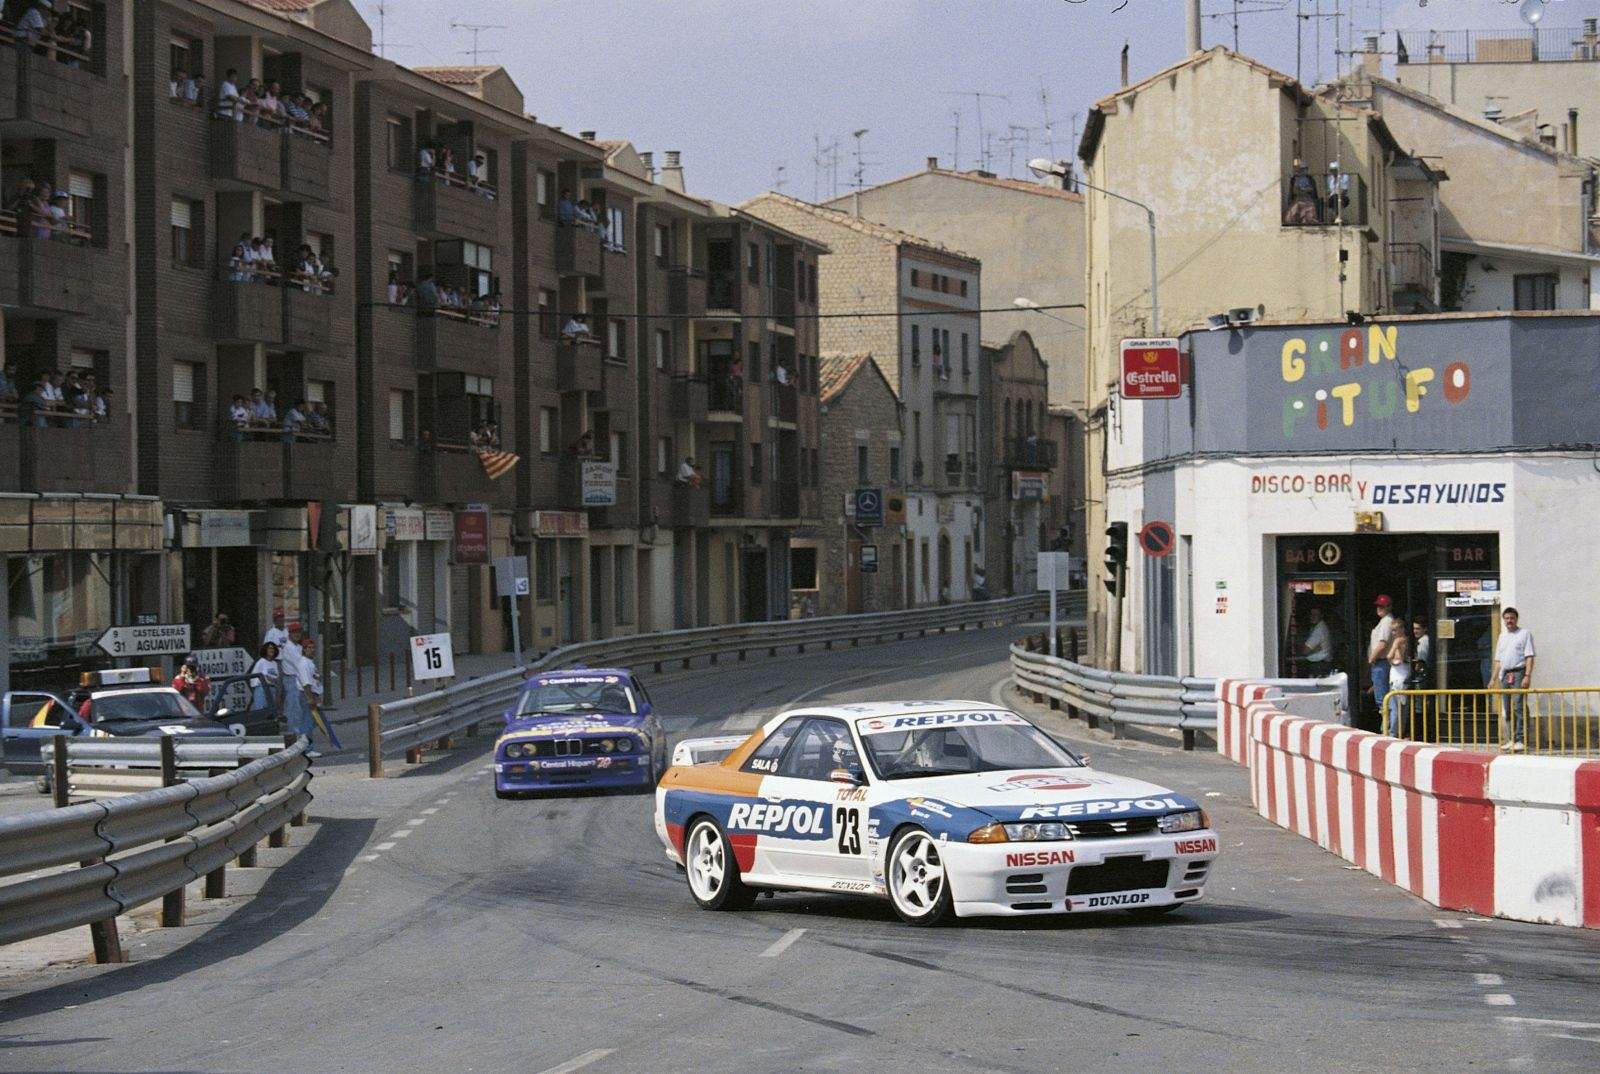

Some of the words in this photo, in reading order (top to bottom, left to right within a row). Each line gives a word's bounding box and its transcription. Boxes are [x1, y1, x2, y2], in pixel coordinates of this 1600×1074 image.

[1281, 325, 1398, 382] GRAN
[1125, 370, 1177, 385] Estrella
[1251, 474, 1353, 494] DISCO-BAR
[1357, 481, 1368, 500] Y
[1372, 483, 1506, 504] DESAYUNOS
[1285, 549, 1315, 563] BAR
[1453, 548, 1485, 561] BAR
[1447, 598, 1470, 606] Trident
[113, 630, 119, 638] 9
[133, 627, 186, 638] CASTELSERAS
[114, 642, 126, 653] 31
[136, 639, 186, 651] AGUAVIVA
[424, 646, 442, 670] 15
[198, 662, 229, 674] ARAGOZA
[231, 661, 245, 673] 103
[893, 713, 1002, 728] REPSOL
[541, 760, 567, 768] Central
[567, 760, 596, 768] Hispano
[751, 758, 770, 771] SALA
[836, 788, 868, 802] TOTAL
[1019, 797, 1186, 819] REPSOL
[727, 803, 825, 834] REPSOL
[836, 807, 862, 855] 23
[1174, 838, 1217, 855] NISSAN
[1006, 850, 1075, 867] NISSAN
[832, 881, 871, 891] DUNLOP
[1088, 893, 1150, 907] DUNLOP
